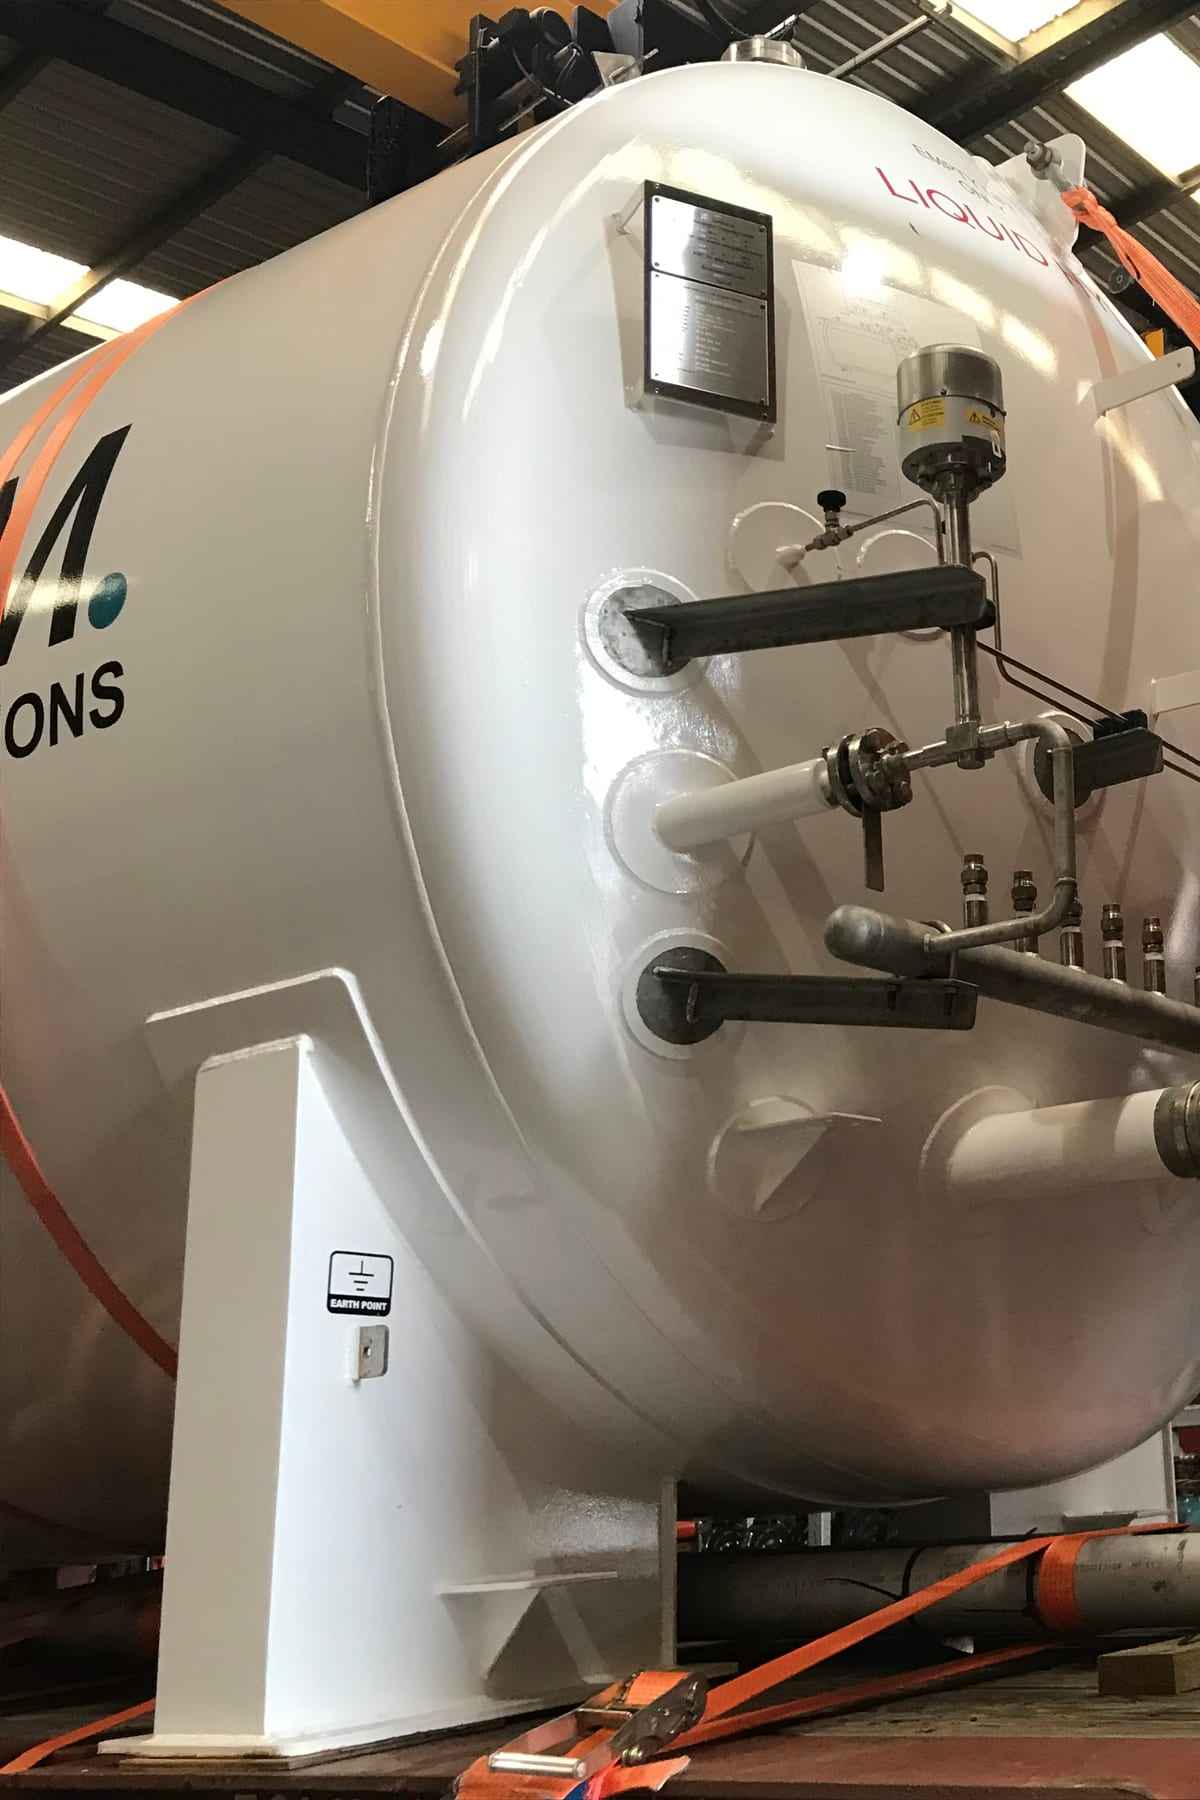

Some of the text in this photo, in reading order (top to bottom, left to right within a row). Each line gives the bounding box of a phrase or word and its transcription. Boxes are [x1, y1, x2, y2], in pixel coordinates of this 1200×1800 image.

[875, 166, 1048, 266] LIQUID
[330, 1298, 387, 1311] EARTH POINT
